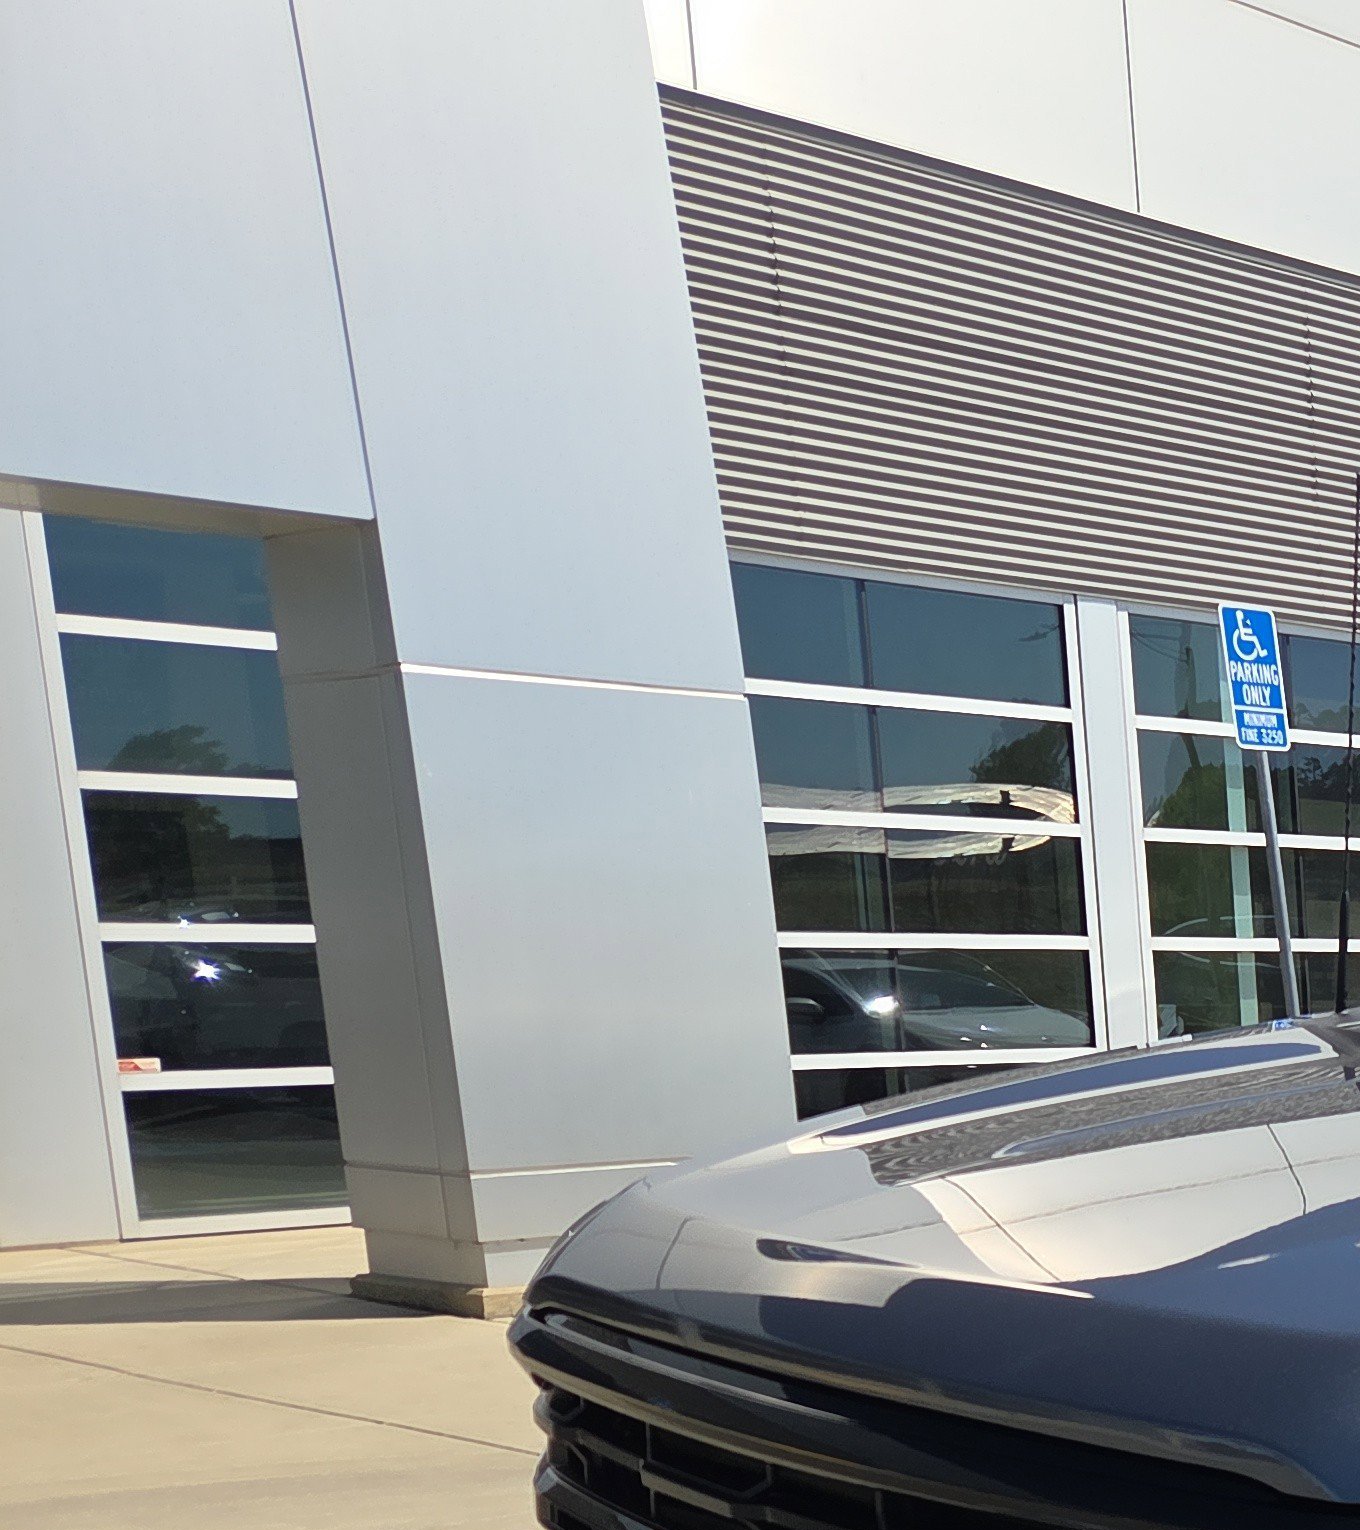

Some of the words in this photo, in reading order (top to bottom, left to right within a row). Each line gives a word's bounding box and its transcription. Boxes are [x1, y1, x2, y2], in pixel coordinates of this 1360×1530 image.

[1230, 660, 1280, 686] PARKING
[1242, 684, 1271, 707] ONLY
[1243, 712, 1278, 728] MINIMUM
